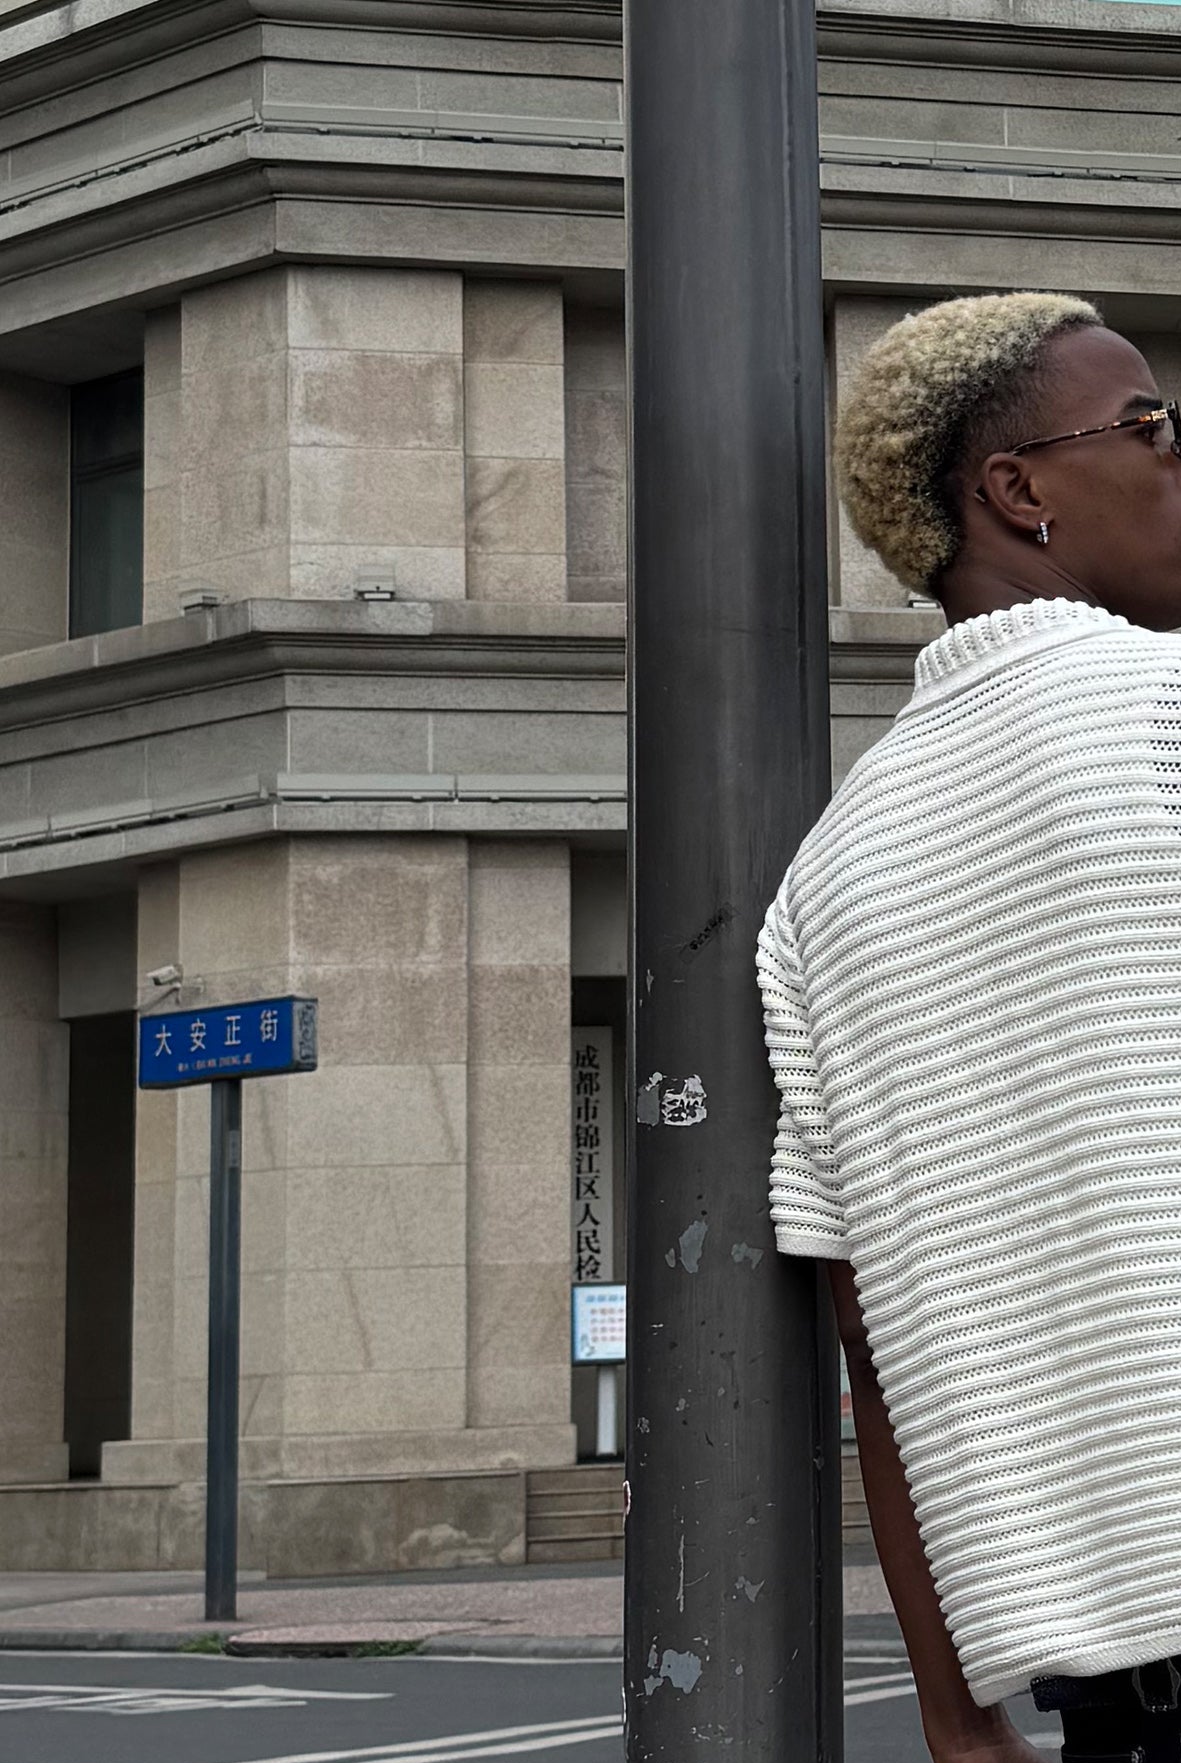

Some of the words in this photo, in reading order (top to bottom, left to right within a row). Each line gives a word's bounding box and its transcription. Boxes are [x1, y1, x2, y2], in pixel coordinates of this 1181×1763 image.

[155, 1009, 278, 1057] 大安正街
[575, 1045, 601, 1281] 成都市锦江区人民检
